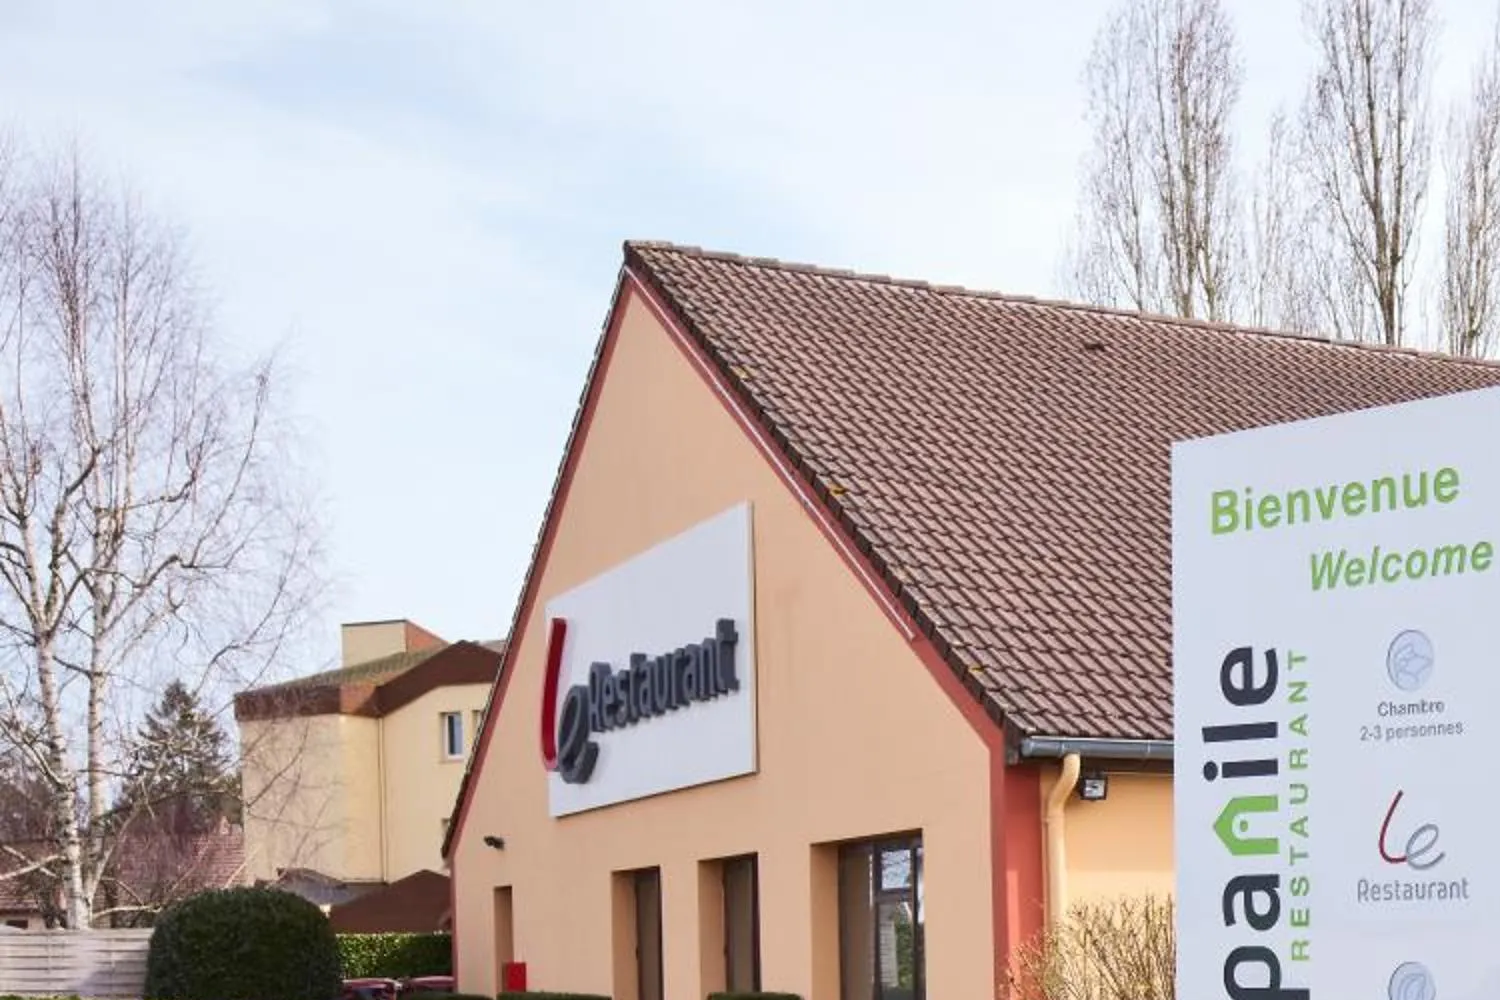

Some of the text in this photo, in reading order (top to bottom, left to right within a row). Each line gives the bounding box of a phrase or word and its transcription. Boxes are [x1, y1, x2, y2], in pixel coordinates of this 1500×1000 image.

[1210, 466, 1461, 535] Bienvenue
[1310, 540, 1495, 592] Welcome
[588, 618, 740, 733] Restaurant
[1360, 720, 1464, 742] 2-3 personnes
[1377, 698, 1445, 718] Chambre
[1288, 649, 1311, 962] RESTAURANT
[1357, 877, 1470, 903] Restaurant
